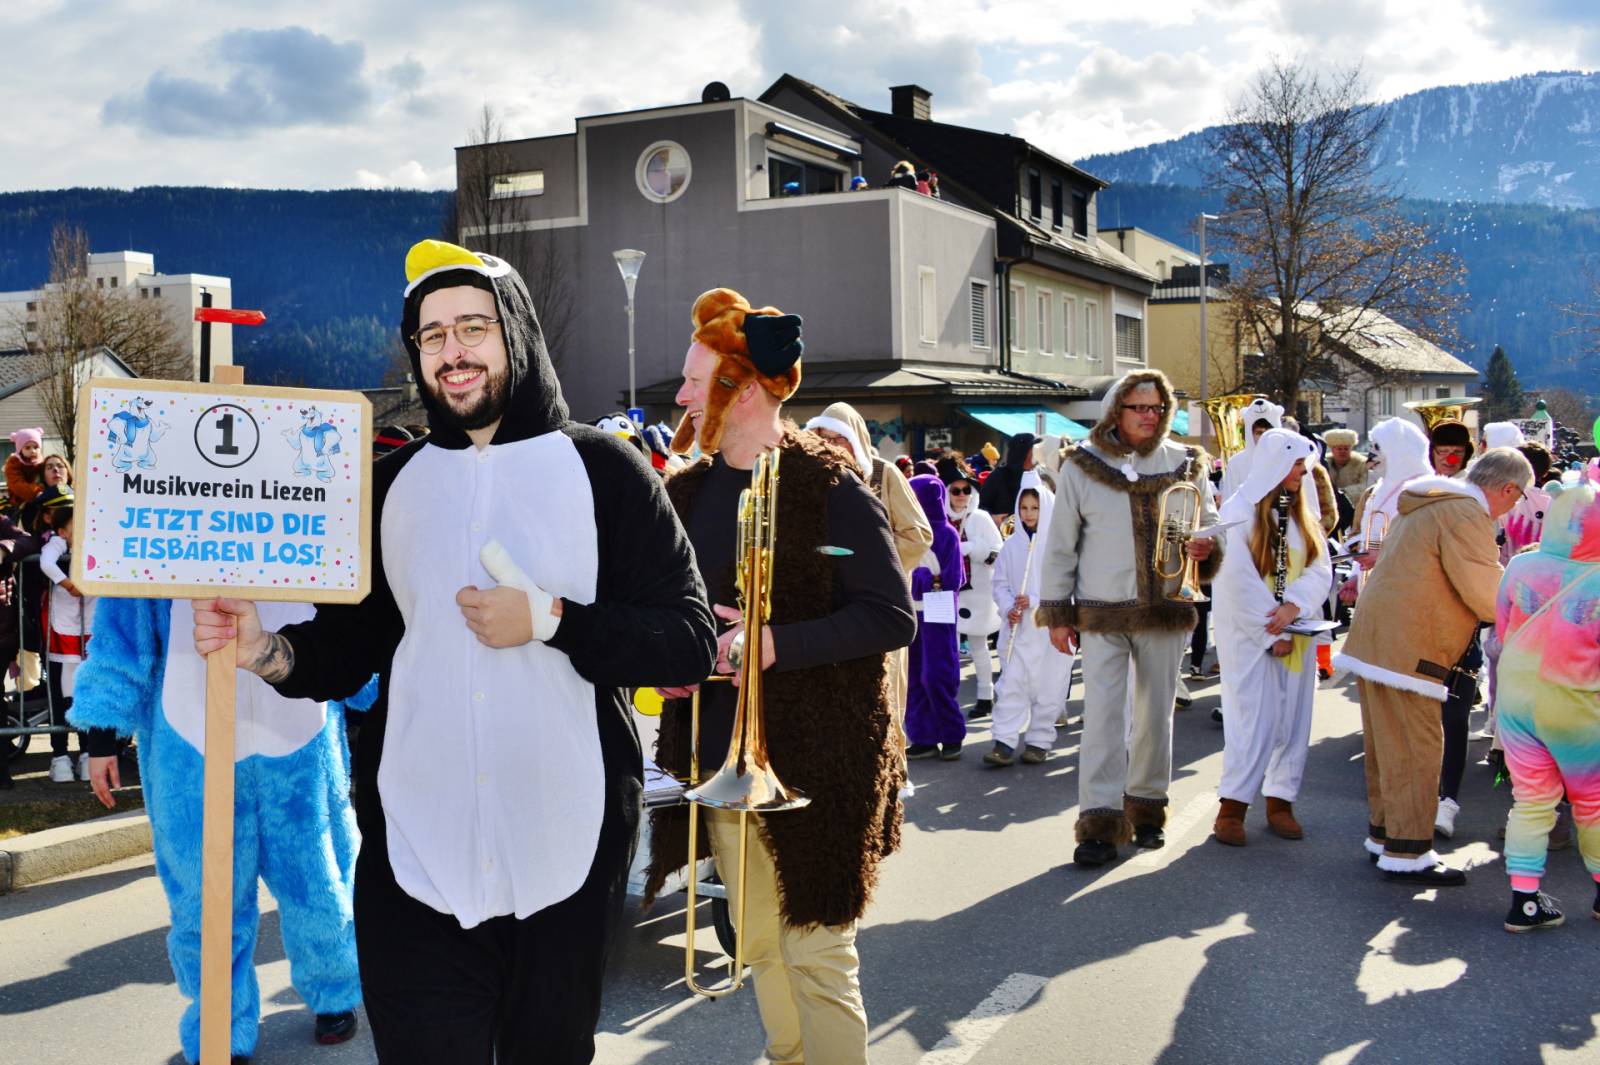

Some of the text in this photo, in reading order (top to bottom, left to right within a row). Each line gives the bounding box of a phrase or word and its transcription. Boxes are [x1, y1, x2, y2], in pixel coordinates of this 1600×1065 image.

[215, 413, 239, 455] 1
[123, 474, 325, 502] Musikverein Liezen
[119, 507, 326, 536] JETZT SIND DIE
[122, 535, 322, 566] EISBÄREN LOS!
